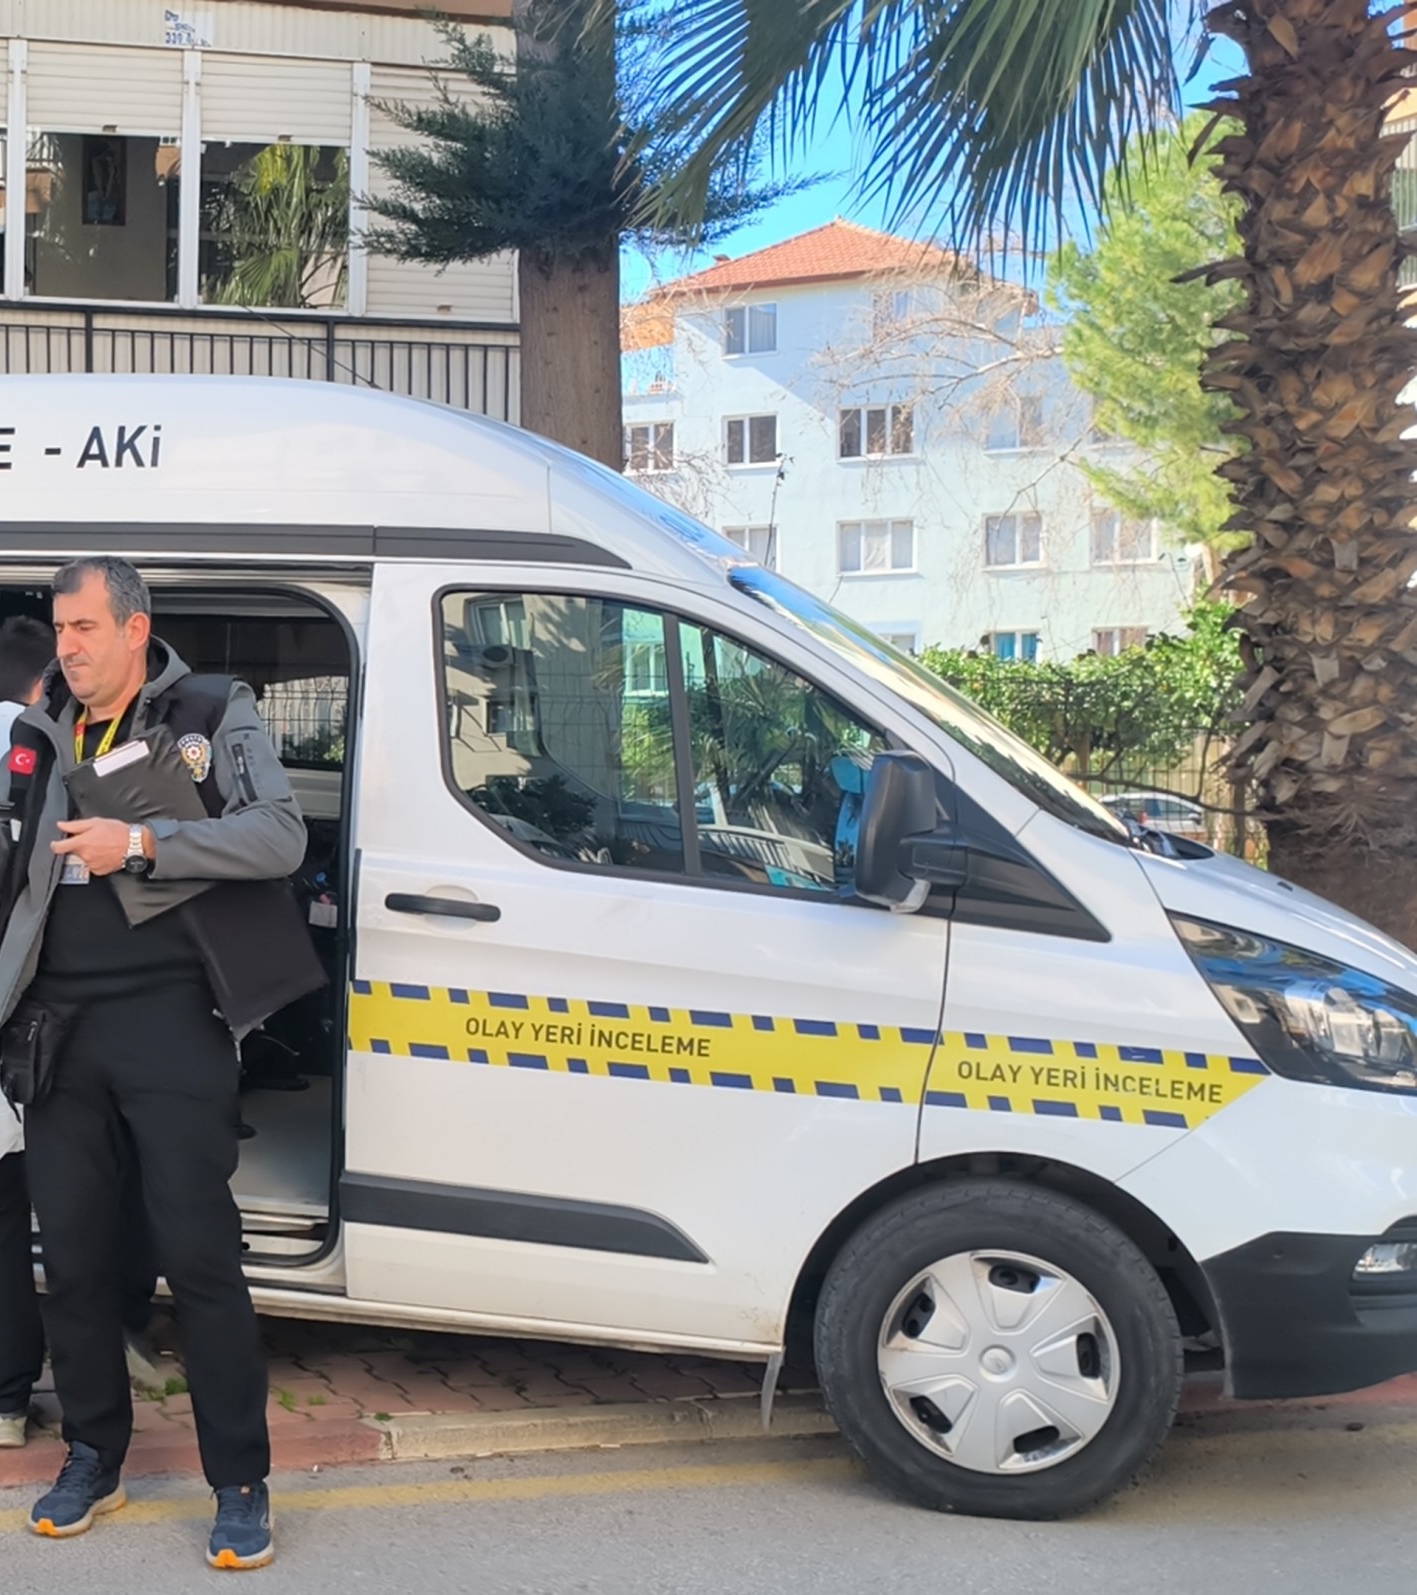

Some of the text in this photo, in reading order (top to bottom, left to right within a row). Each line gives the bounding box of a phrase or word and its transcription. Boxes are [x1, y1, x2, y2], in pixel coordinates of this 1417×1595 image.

[465, 1018, 712, 1058] OLAY YERİ İNCELEME
[957, 1060, 1224, 1104] OLAY YERİ İNCELEME
